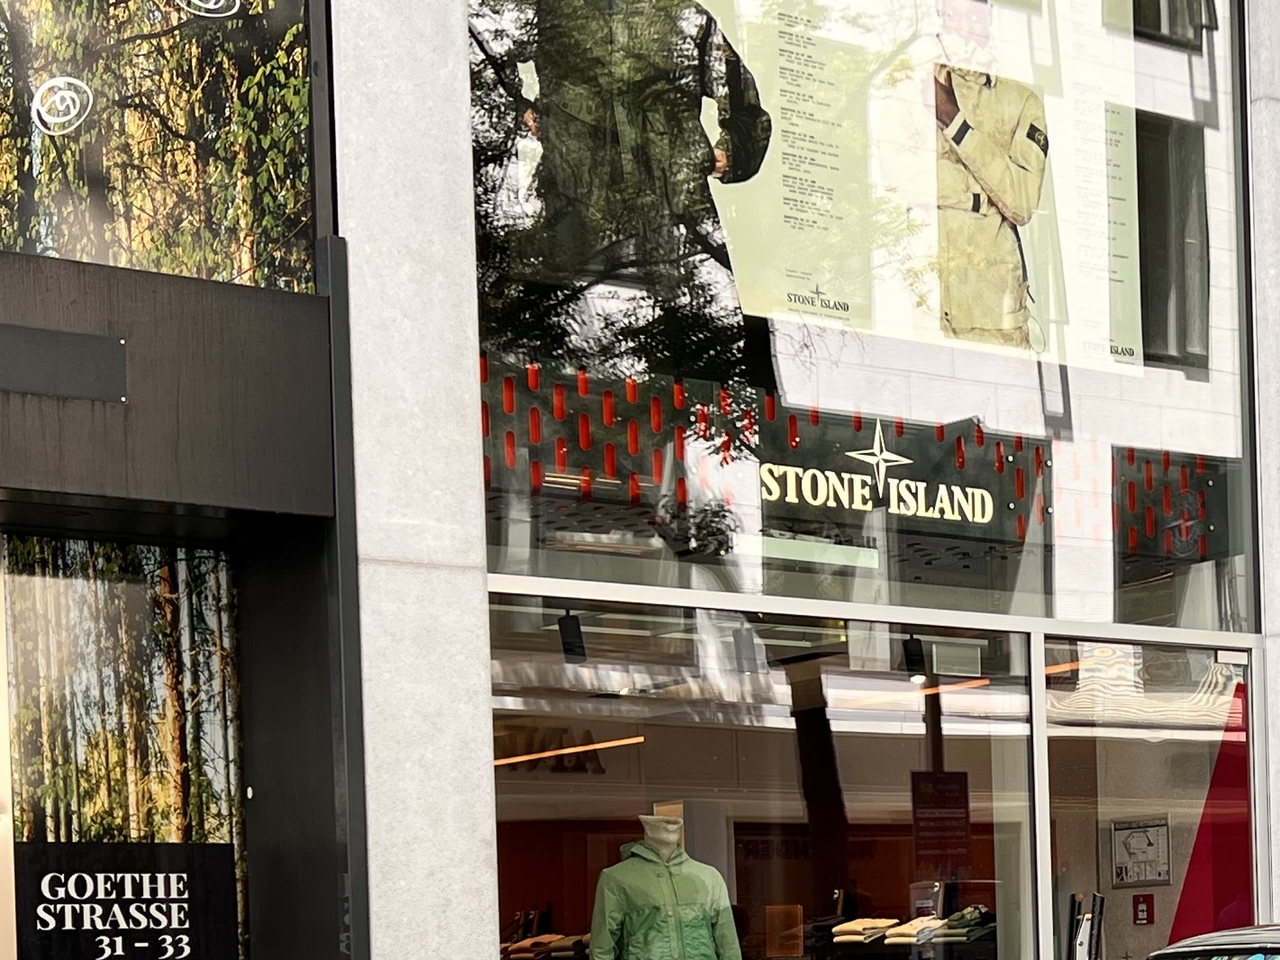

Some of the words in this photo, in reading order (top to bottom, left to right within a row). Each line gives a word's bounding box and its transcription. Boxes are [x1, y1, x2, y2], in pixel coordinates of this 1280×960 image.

[786, 292, 816, 307] STONE
[820, 298, 850, 313] ISLAND
[1110, 345, 1135, 357] ISLAND
[759, 462, 873, 512] STONE
[886, 477, 995, 524] ISLAND
[40, 872, 190, 900] GOETHE
[36, 903, 190, 931] STRASSE
[94, 935, 125, 960] 31
[158, 934, 191, 960] 33
